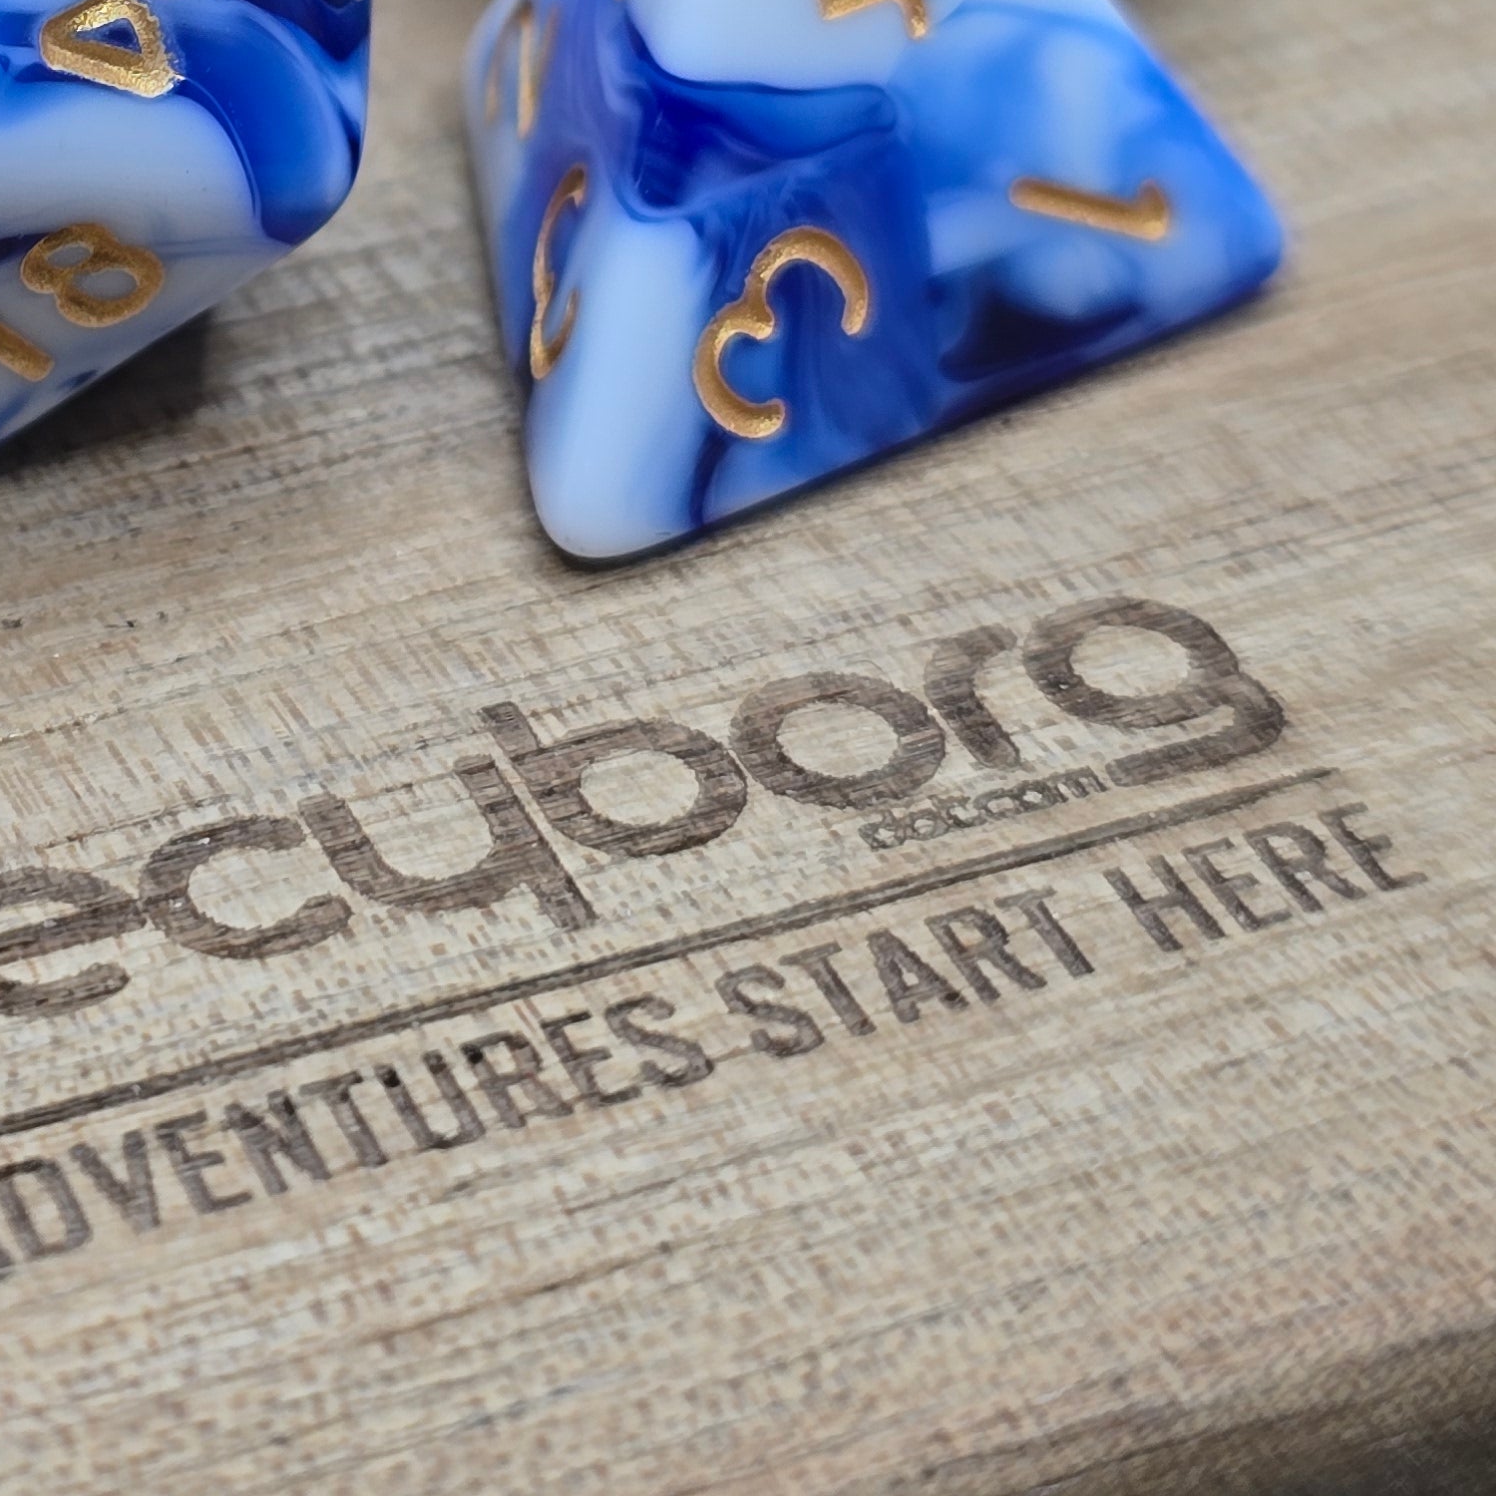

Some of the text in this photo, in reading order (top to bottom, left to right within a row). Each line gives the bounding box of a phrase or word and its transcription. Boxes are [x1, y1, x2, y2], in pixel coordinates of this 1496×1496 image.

[691, 226, 871, 441] 3
[716, 887, 1096, 1057] START
[1106, 802, 1428, 954] HERE
